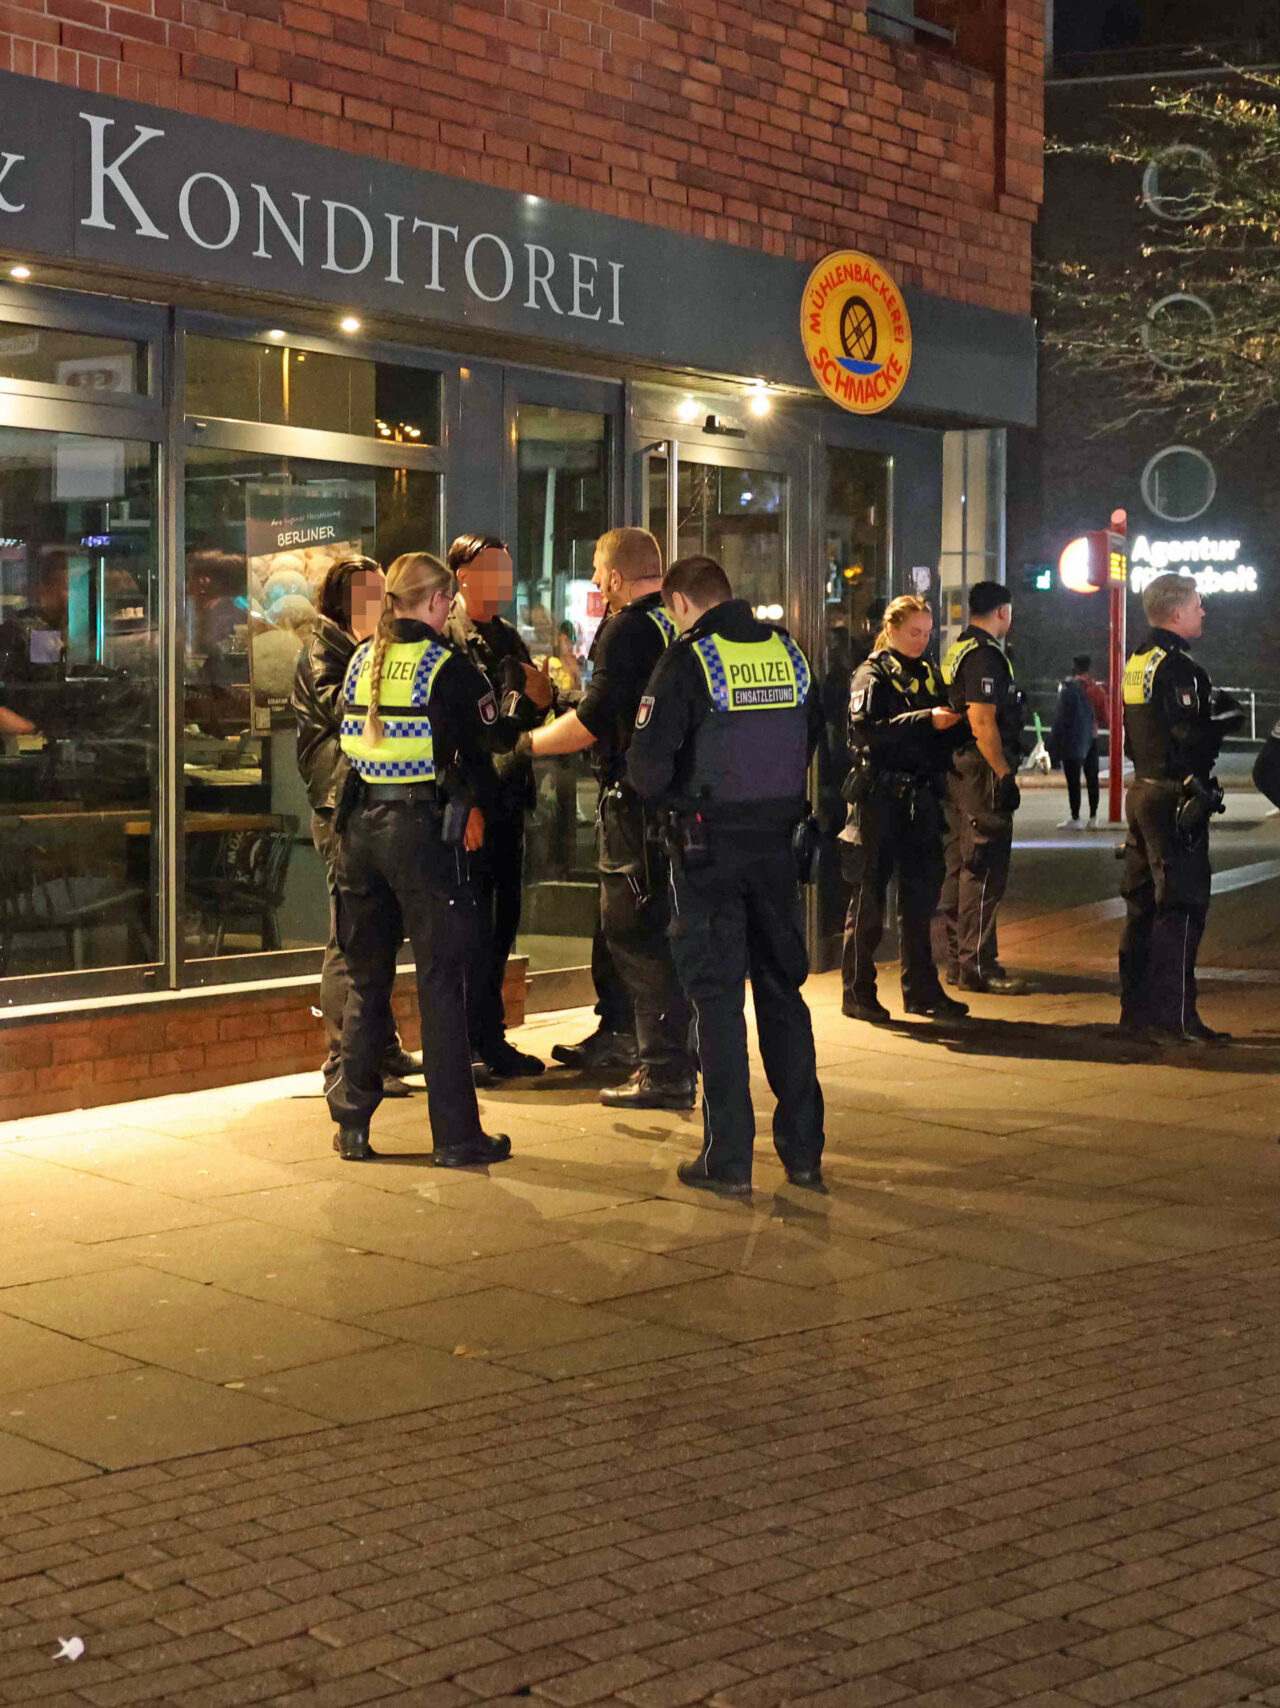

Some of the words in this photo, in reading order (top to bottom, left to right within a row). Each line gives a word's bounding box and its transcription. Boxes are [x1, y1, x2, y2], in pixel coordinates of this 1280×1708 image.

[809, 262, 905, 344] MÜHLENBÄCKEREI
[813, 346, 903, 404] SCHMACKE
[277, 525, 336, 547] BERLINER
[1130, 535, 1241, 568] Agentur
[360, 660, 417, 681] PIZEI
[729, 661, 791, 685] POLIZEI
[734, 687, 794, 705] EINSATZLEITUNG
